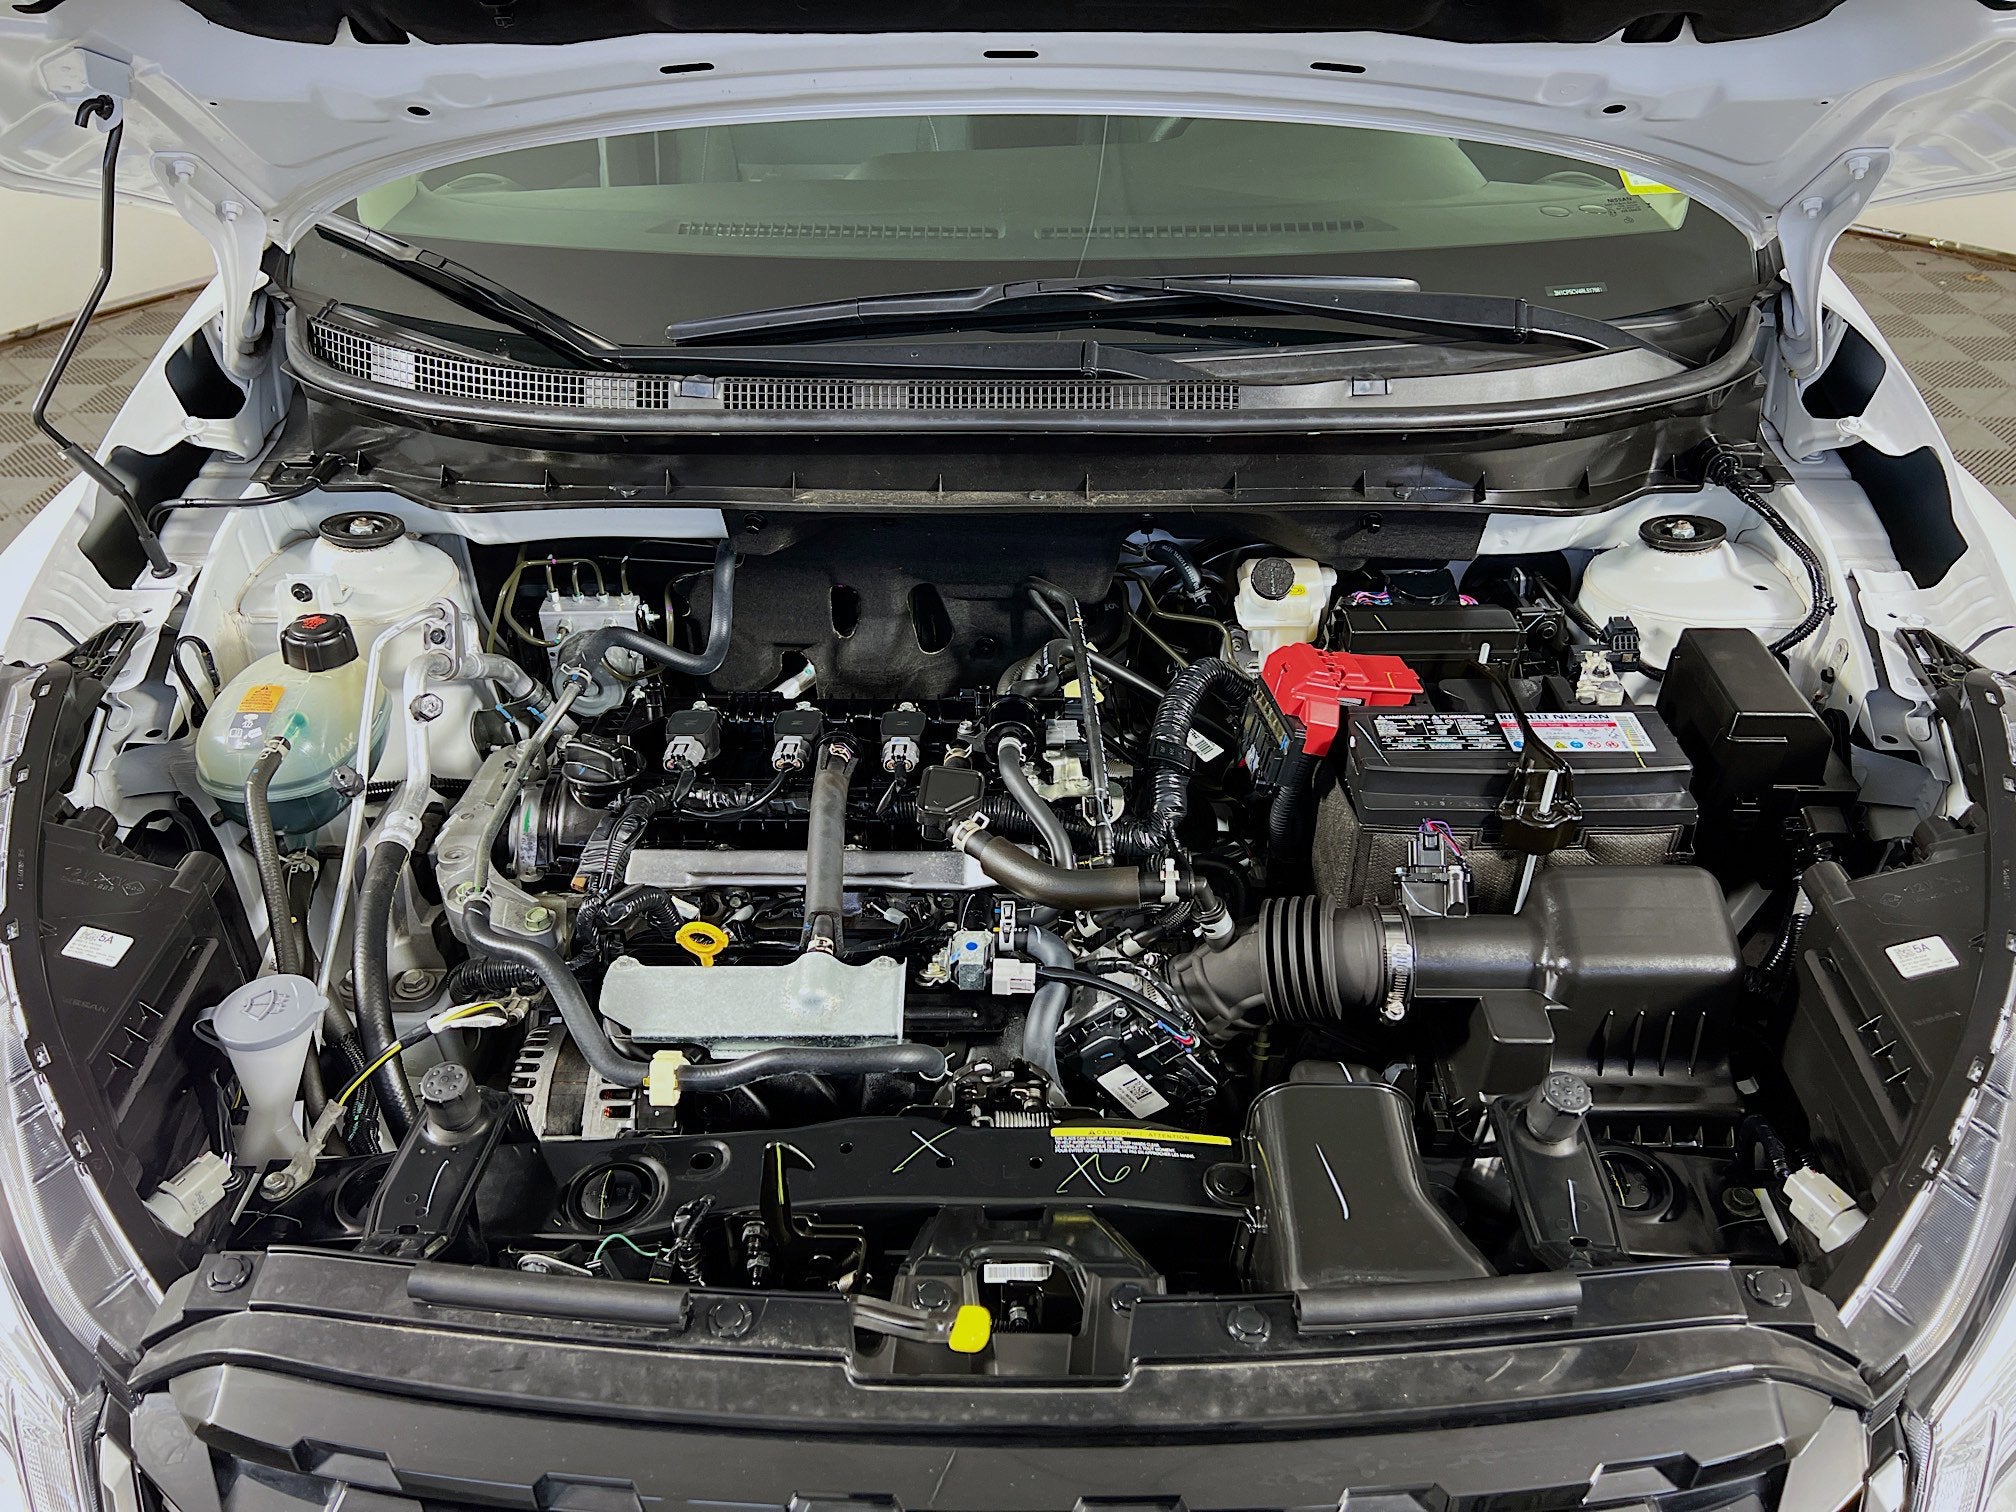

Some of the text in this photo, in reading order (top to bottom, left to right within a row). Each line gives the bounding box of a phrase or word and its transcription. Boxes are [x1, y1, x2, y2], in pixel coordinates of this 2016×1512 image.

[328, 732, 357, 766] MAX
[98, 933, 114, 944] 5A
[1912, 943, 1932, 954] 5A
